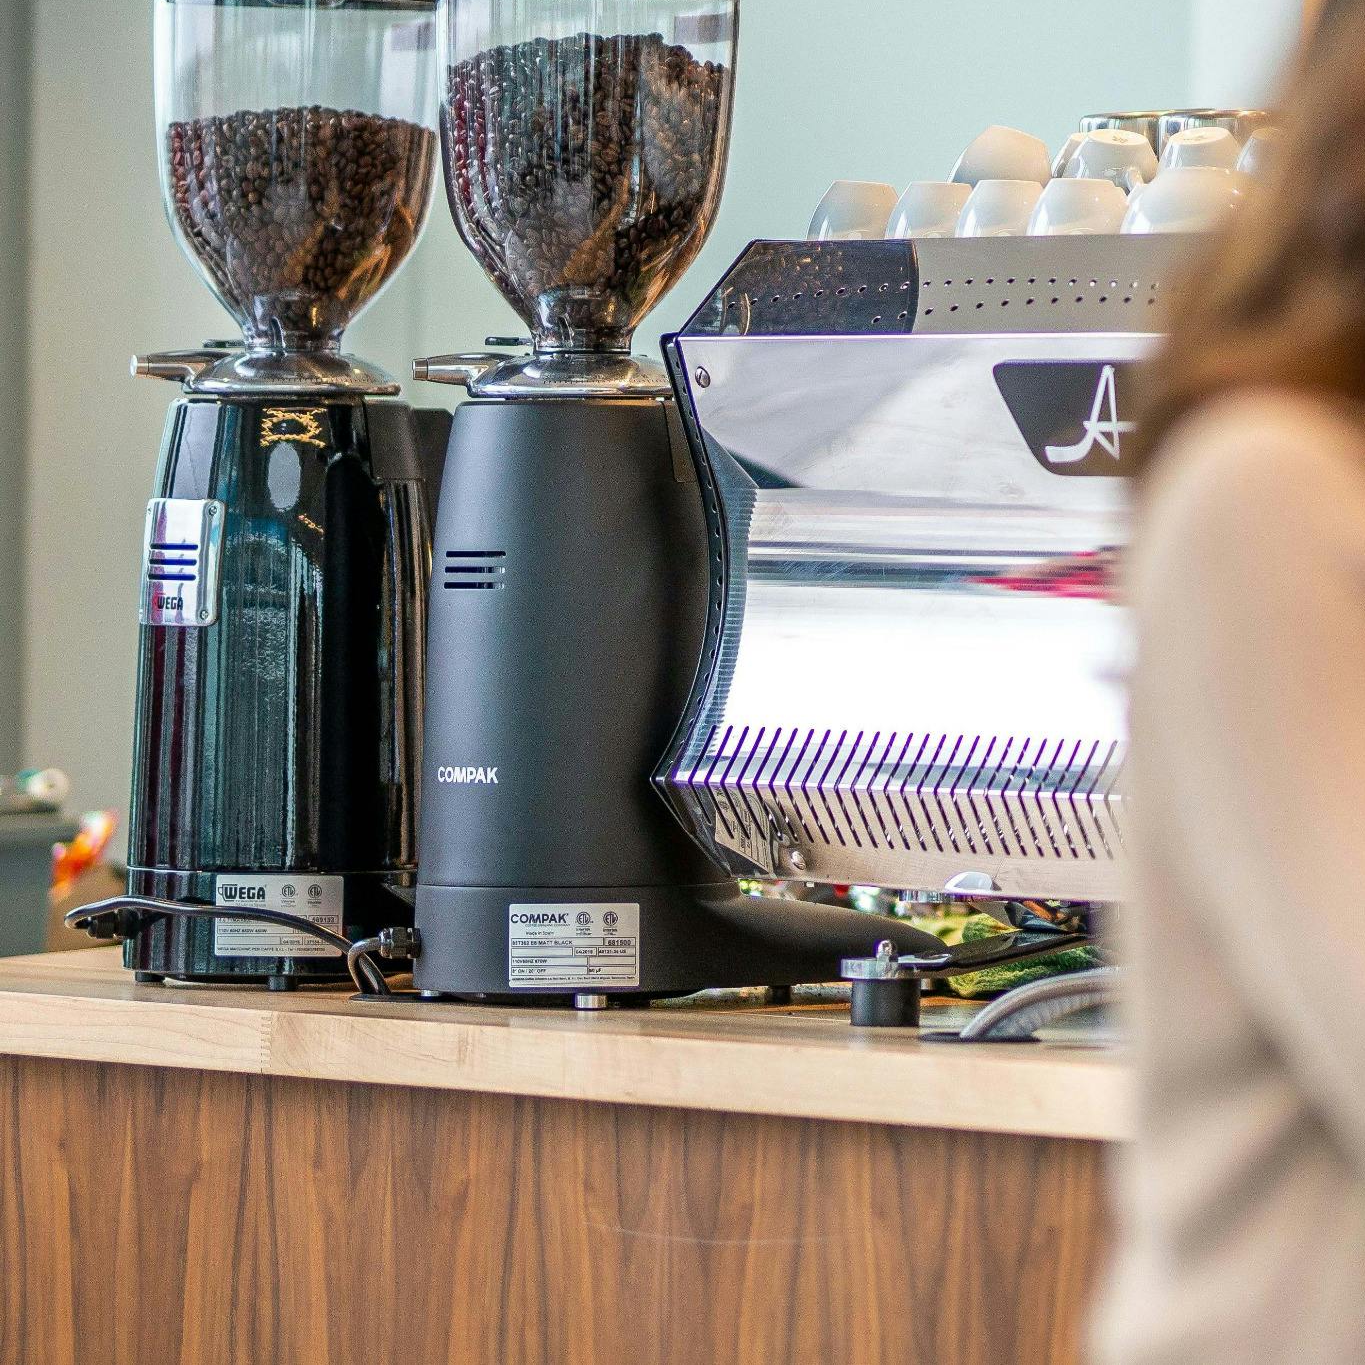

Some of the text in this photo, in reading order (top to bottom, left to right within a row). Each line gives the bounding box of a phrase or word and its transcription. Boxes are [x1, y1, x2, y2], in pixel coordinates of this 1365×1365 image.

[156, 595, 184, 611] WEGA
[437, 766, 499, 784] COMPAK
[224, 886, 266, 900] WEGA
[510, 913, 567, 924] COMPAK
